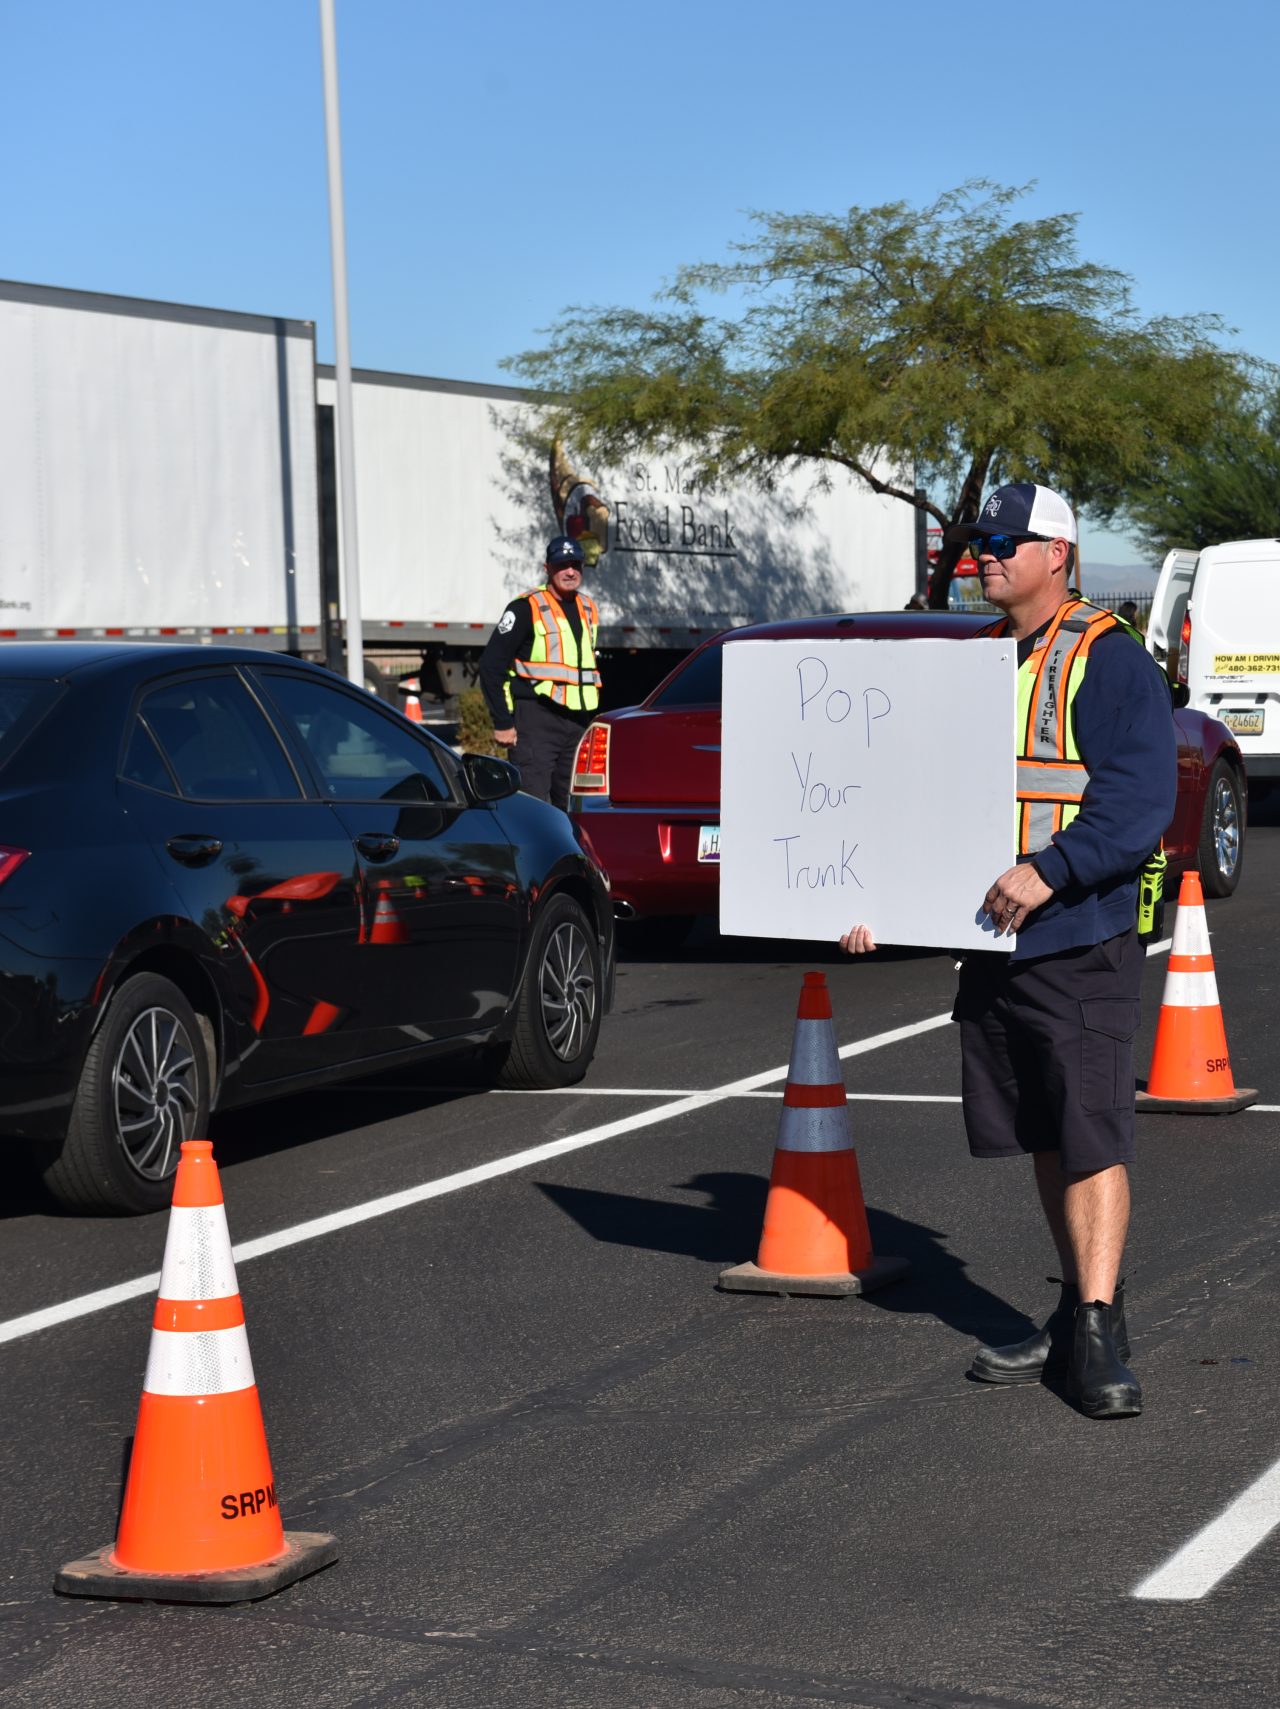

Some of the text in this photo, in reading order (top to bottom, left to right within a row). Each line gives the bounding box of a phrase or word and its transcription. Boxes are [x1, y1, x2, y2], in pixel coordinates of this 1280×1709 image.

[635, 463, 657, 492] St.
[614, 501, 737, 549] Food Bank
[797, 656, 891, 749] Pop
[1040, 649, 1062, 743] FIREFIGHTER
[791, 751, 862, 813] Your
[1206, 1057, 1229, 1073] SRP
